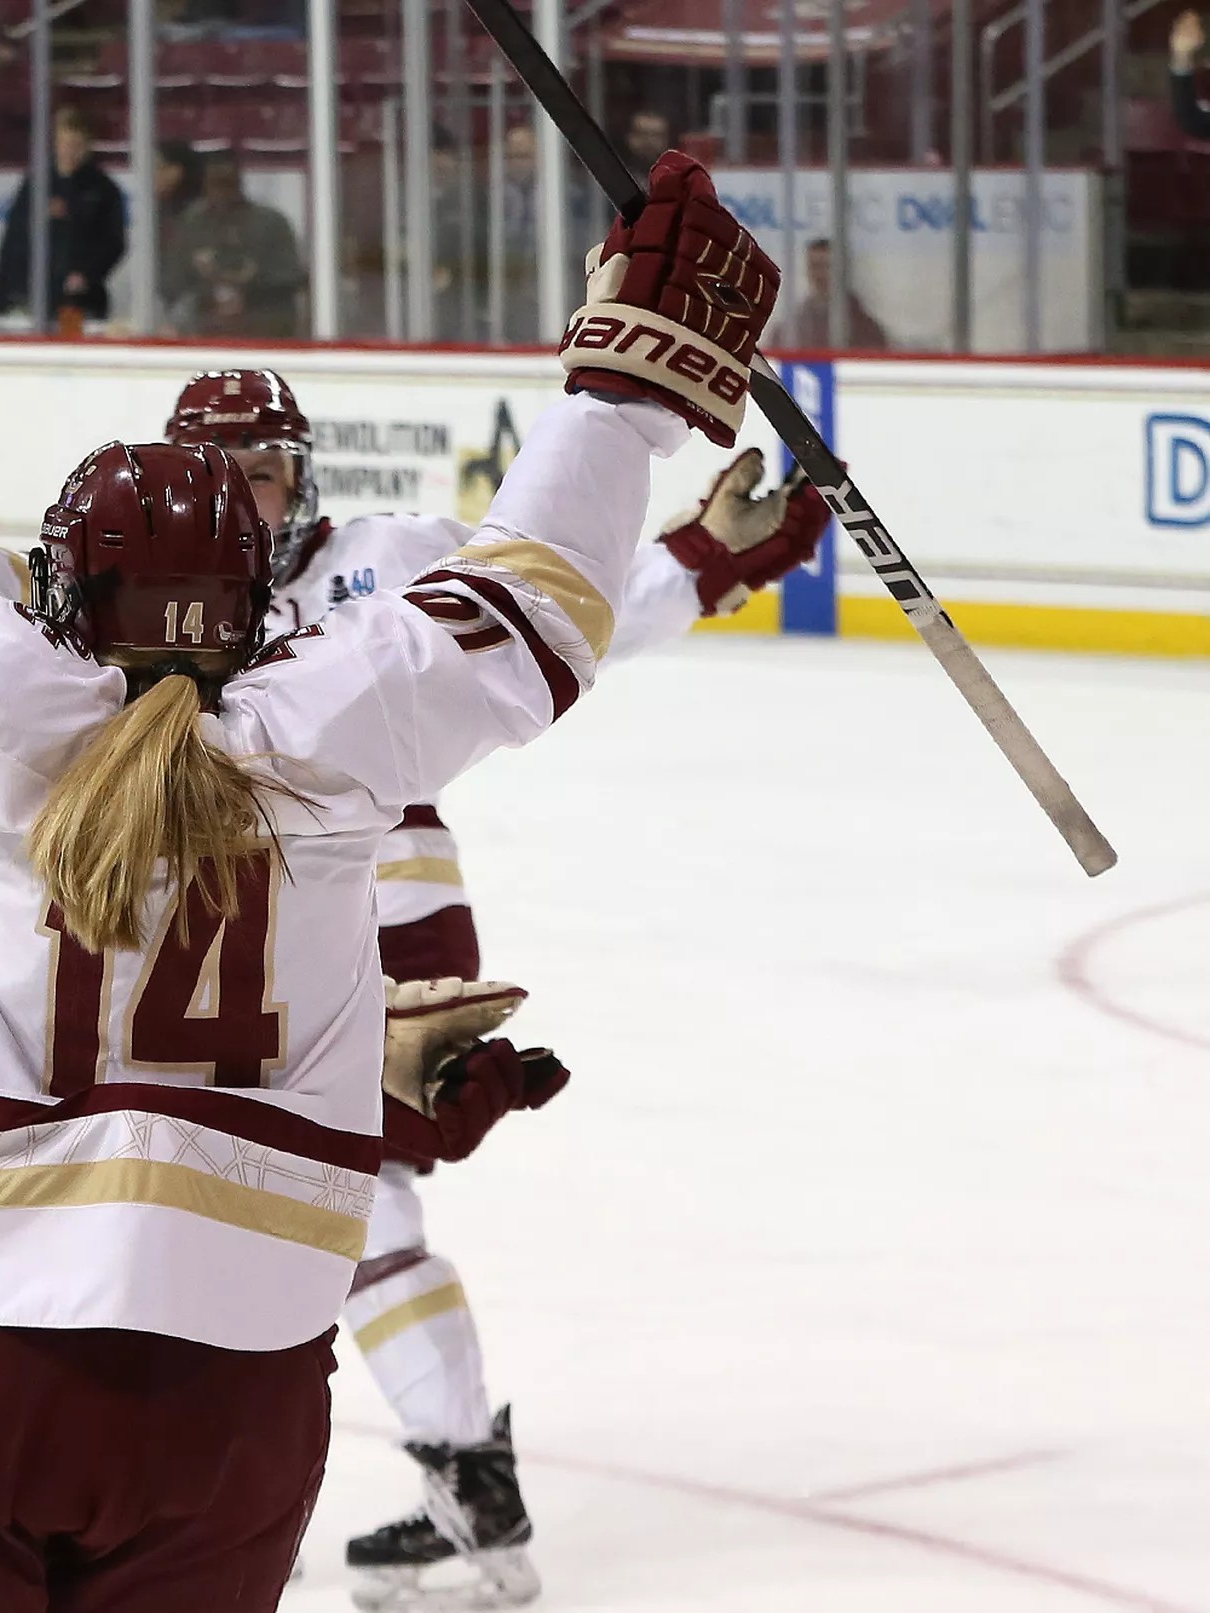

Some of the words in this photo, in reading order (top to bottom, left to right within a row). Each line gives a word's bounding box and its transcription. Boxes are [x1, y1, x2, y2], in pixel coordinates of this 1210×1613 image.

[311, 419, 451, 455] EMOLITION
[315, 463, 418, 498] OMPANY
[164, 601, 205, 644] 14
[34, 832, 289, 1096] 14
